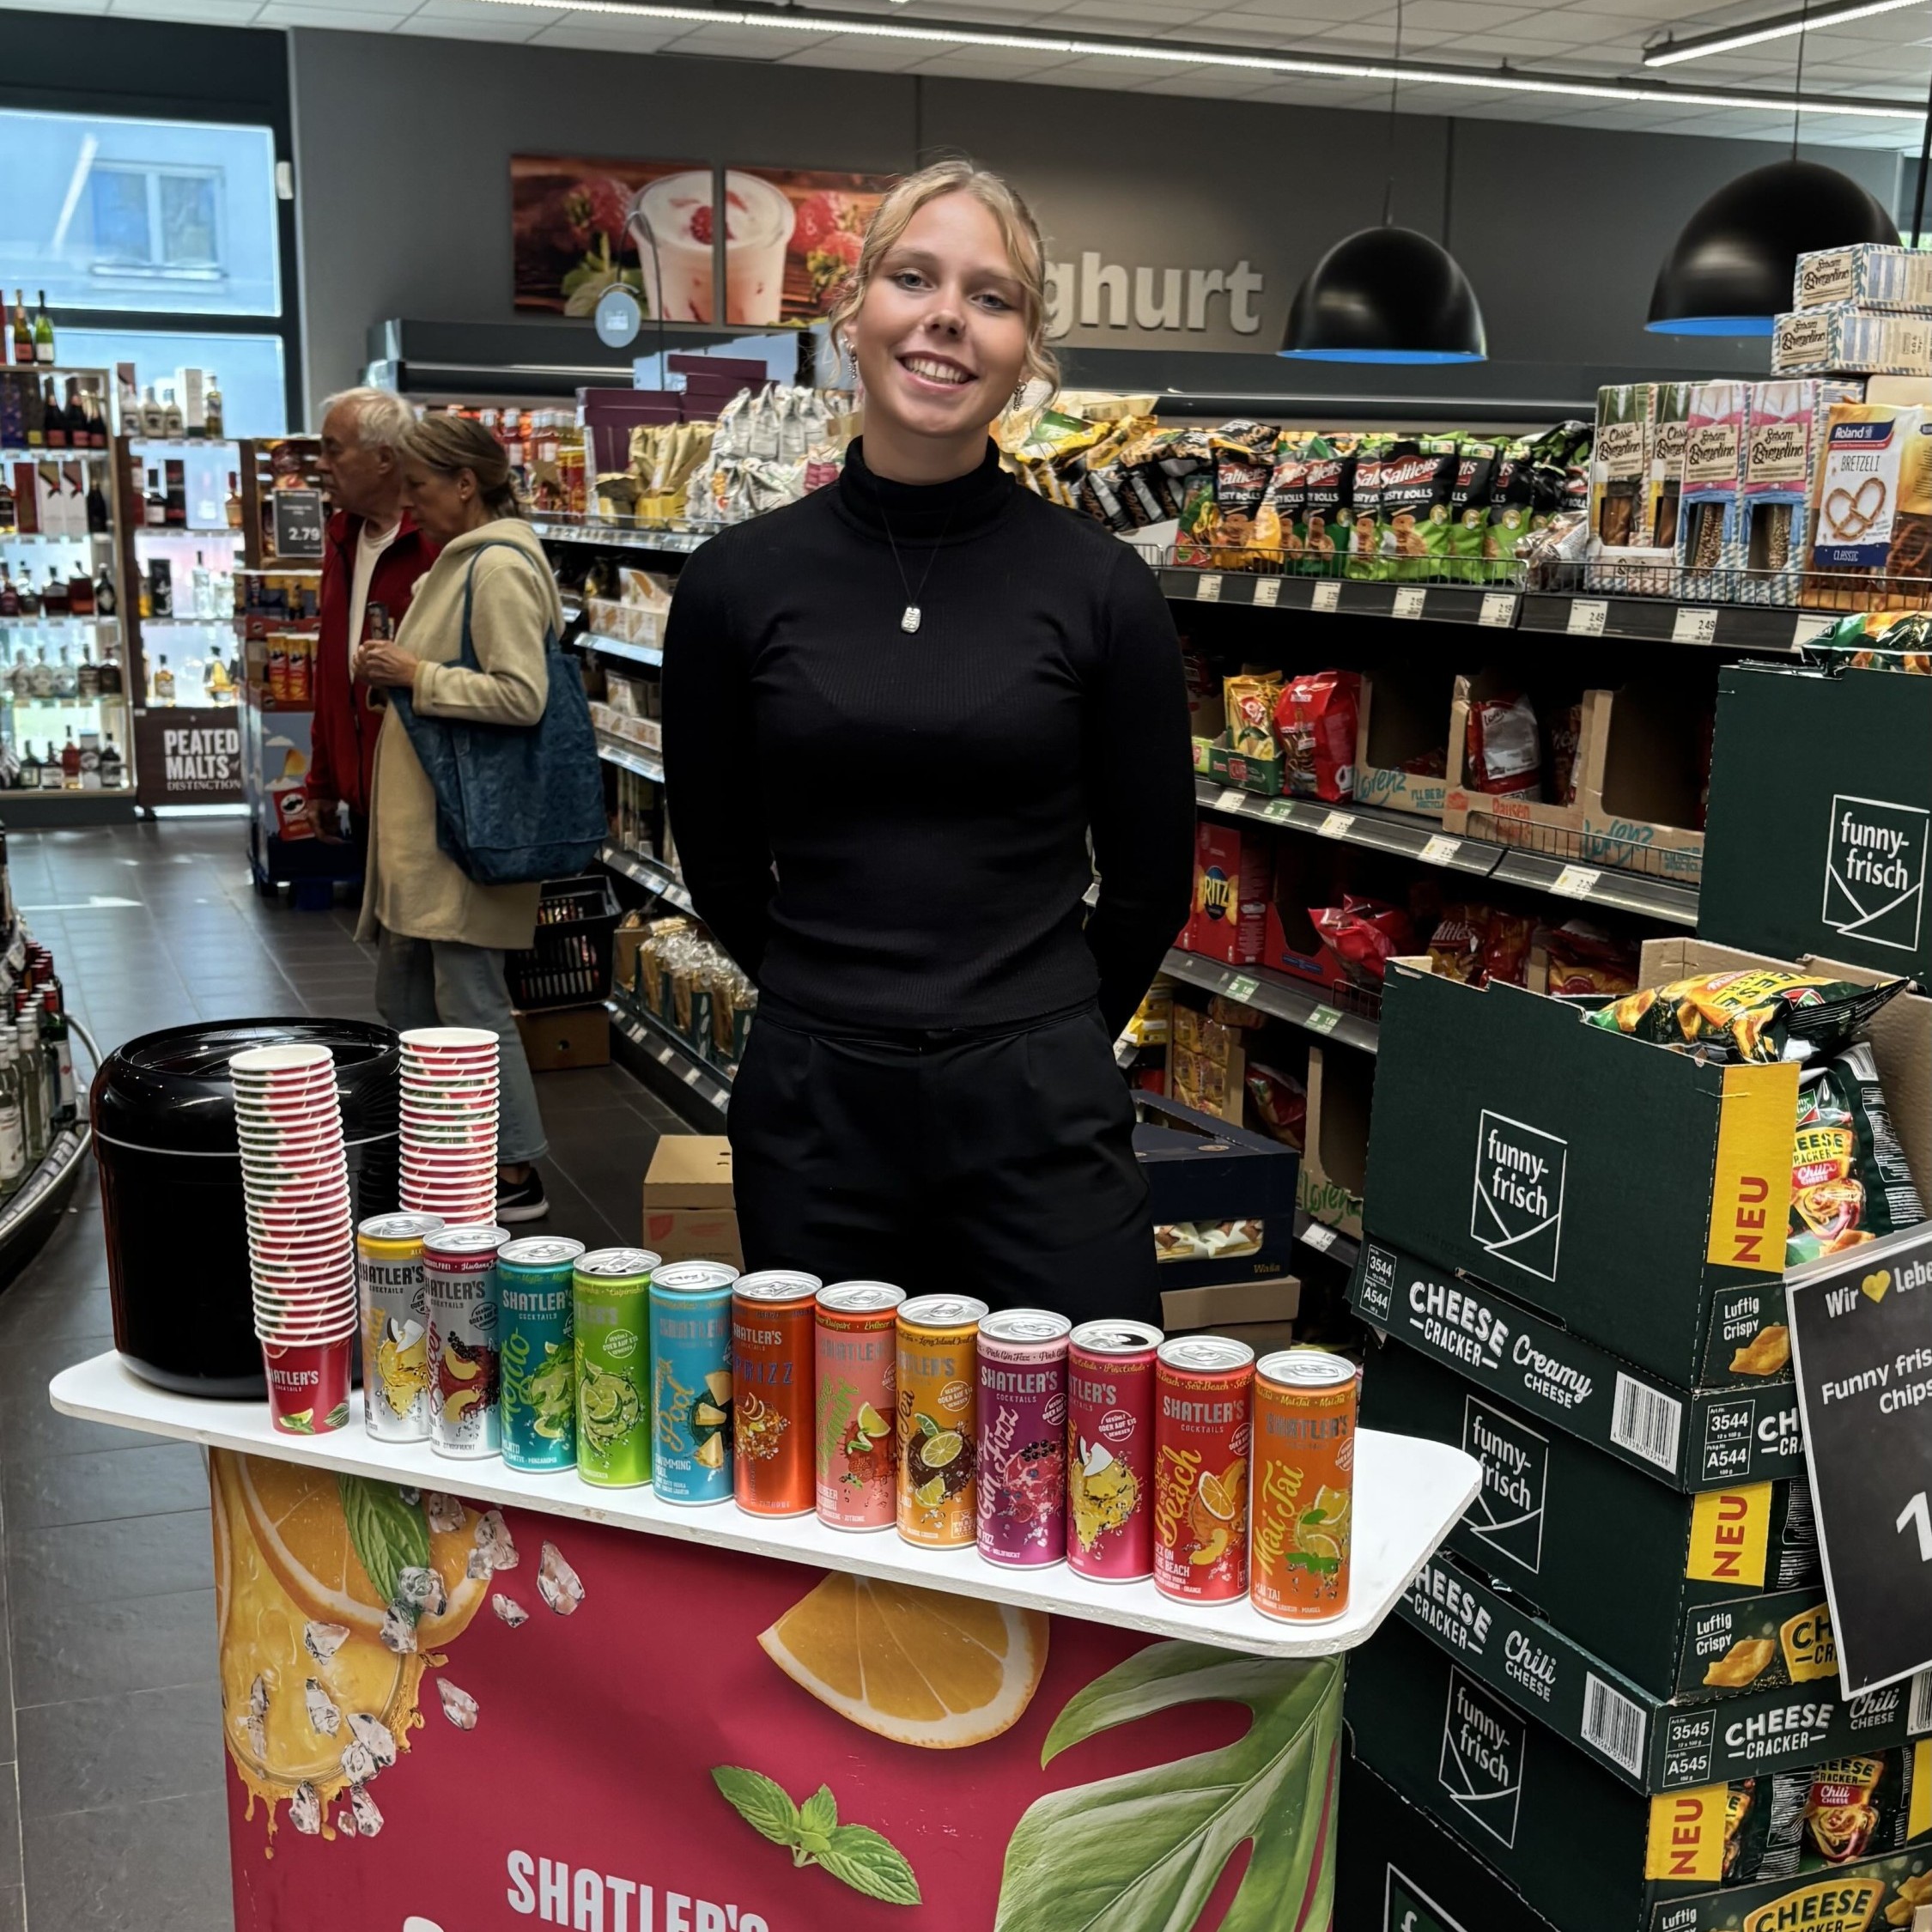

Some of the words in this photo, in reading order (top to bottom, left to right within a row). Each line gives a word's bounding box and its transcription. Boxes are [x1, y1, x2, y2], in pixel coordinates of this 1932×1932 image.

[1834, 427, 1864, 439] Roland
[1753, 442, 1803, 465] Brezelino
[1841, 455, 1880, 471] BRETZELI
[1403, 488, 1433, 499] ROLLS
[289, 527, 320, 541] 2.79
[164, 729, 240, 755] PEATED
[165, 756, 229, 780] MALTS
[167, 780, 241, 791] DISTINCTION
[1841, 811, 1910, 859] funny-
[1846, 848, 1908, 891] frisch
[1204, 876, 1229, 908] RITZ
[1795, 1133, 1844, 1152] EESE
[1488, 1128, 1549, 1184] funny-
[1492, 1166, 1548, 1218] frisch
[1732, 1176, 1769, 1262] NEU
[1370, 1256, 1392, 1278] 3544
[1364, 1286, 1388, 1309] A544
[1724, 1297, 1759, 1320] Luftig
[1825, 1286, 1859, 1318] Wir
[1723, 1318, 1759, 1340] Crispy
[1409, 1281, 1509, 1357] CHEESE
[1512, 1334, 1592, 1404] Creamy
[981, 1365, 1057, 1394] SHATLER'S
[1523, 1372, 1573, 1409] CHEESE
[1822, 1364, 1889, 1405] Funny
[996, 1393, 1036, 1403] COCKTAILS
[1163, 1395, 1244, 1424] SHATLER'S
[1098, 1423, 1115, 1432] ODER
[1115, 1420, 1127, 1429] AUF
[1181, 1424, 1224, 1434] COCKTAILS
[1710, 1412, 1748, 1431] 3544
[1473, 1416, 1532, 1475] funny-
[1707, 1448, 1747, 1468] A544
[1262, 1461, 1304, 1517] Tai
[1480, 1453, 1530, 1511] frisch
[1155, 1444, 1202, 1547] Beach
[1254, 1512, 1285, 1576] Mai
[1711, 1495, 1748, 1577] NEU
[1165, 1559, 1190, 1577] BEACH
[1414, 1564, 1492, 1643] HEESE
[1504, 1630, 1557, 1686] Chili
[1697, 1613, 1732, 1636] Luftig
[1696, 1633, 1733, 1656] Crispy
[1504, 1660, 1551, 1703] CHEESE
[1456, 1686, 1510, 1747] funny-
[1725, 1704, 1835, 1747] CHEESE
[1849, 1687, 1900, 1719] Chili
[1850, 1711, 1895, 1730] CHEESE
[1672, 1721, 1710, 1741] 3545
[1461, 1726, 1510, 1787] frisch
[1667, 1755, 1707, 1776] A545
[1820, 1785, 1850, 1798] Chili
[1668, 1798, 1704, 1875] NEU
[1662, 1908, 1697, 1930] Luftig
[1755, 1889, 1872, 1932] CHEESE
